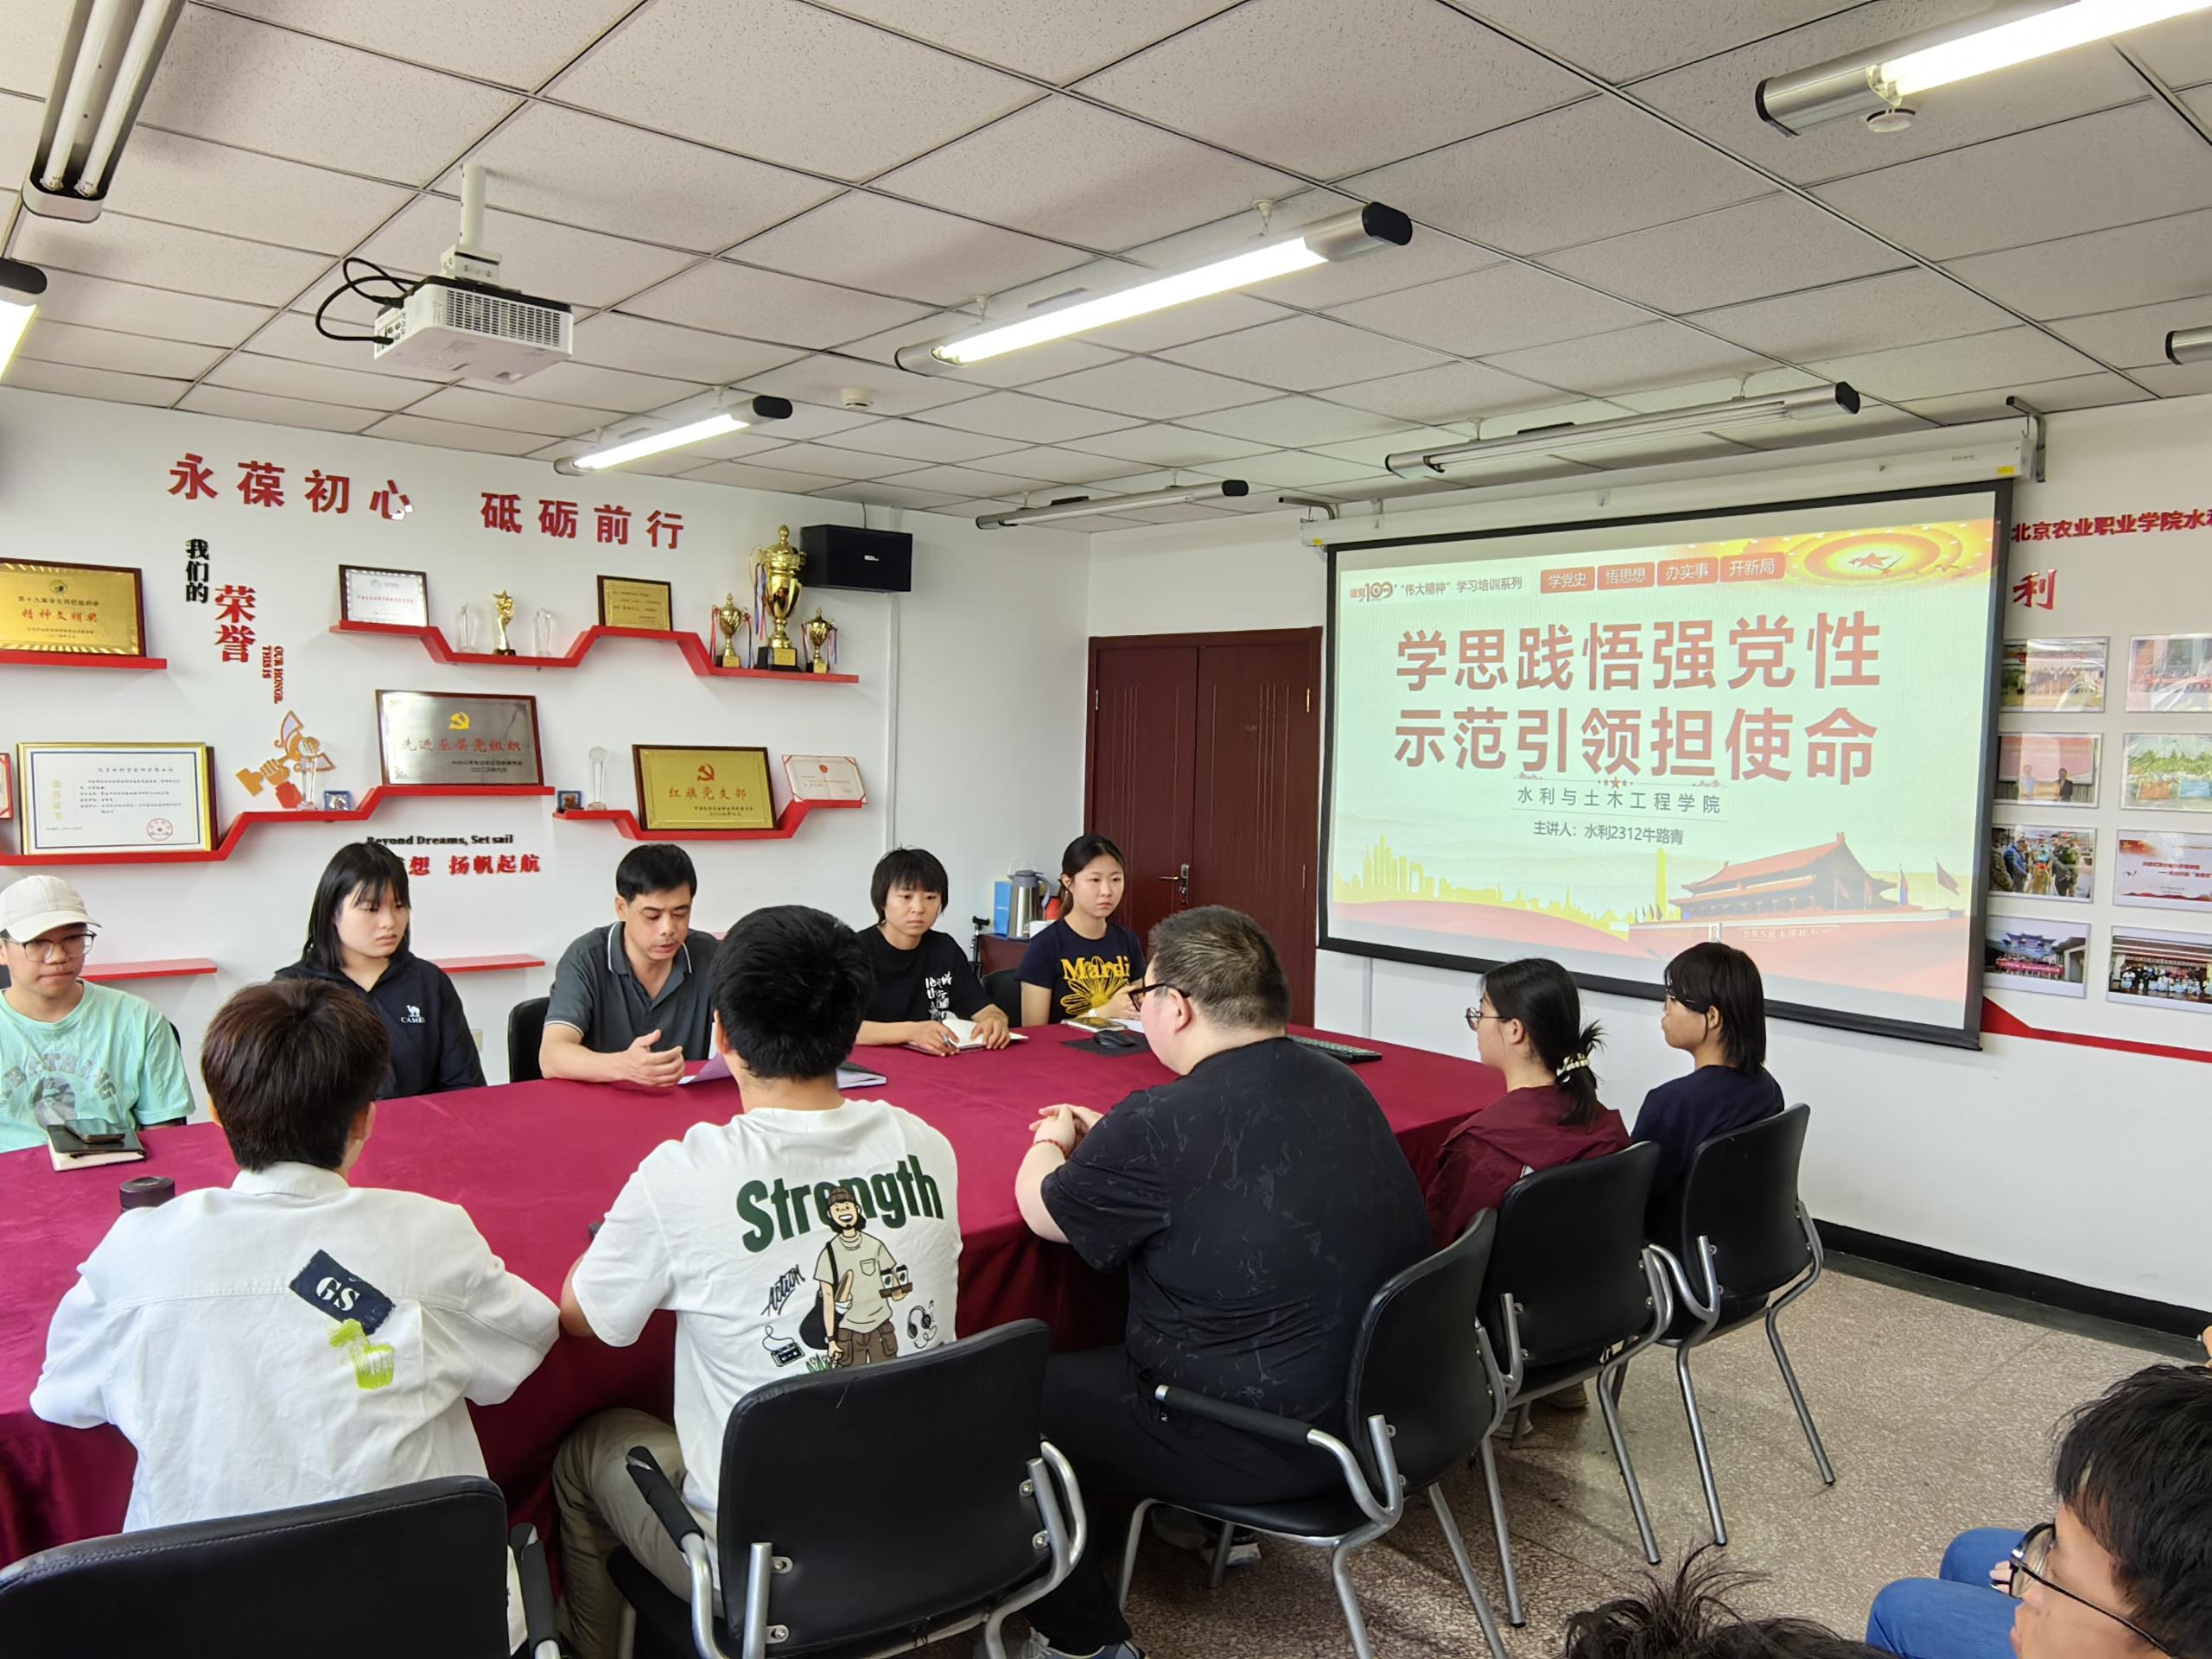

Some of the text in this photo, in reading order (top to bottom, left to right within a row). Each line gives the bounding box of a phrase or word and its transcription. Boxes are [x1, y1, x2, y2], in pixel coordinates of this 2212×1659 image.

[168, 453, 684, 549] 永葆初心 砥砺前行
[186, 538, 209, 604] 我们的
[1605, 568, 1646, 584] 悟思想
[1666, 563, 1708, 581] 办实事
[1729, 558, 1776, 576] 开新局
[1548, 573, 1586, 588] 学党史
[2012, 569, 2056, 610] 利
[214, 584, 256, 663] 荣誉
[274, 646, 283, 666] OUR
[1396, 611, 1880, 691] 学思践悟强党性
[402, 737, 522, 753] 先进基层党组织
[1395, 706, 1878, 786] 示范引领担使命
[669, 786, 747, 800] 红旗党支部
[1517, 786, 1720, 814] 水利与土木工程学院
[367, 836, 413, 846] Beyond
[471, 835, 489, 844] Set
[493, 835, 513, 843] sail
[406, 855, 541, 875] 想 扬帆起航
[736, 1154, 944, 1253] Strength
[316, 1276, 360, 1312] GS
